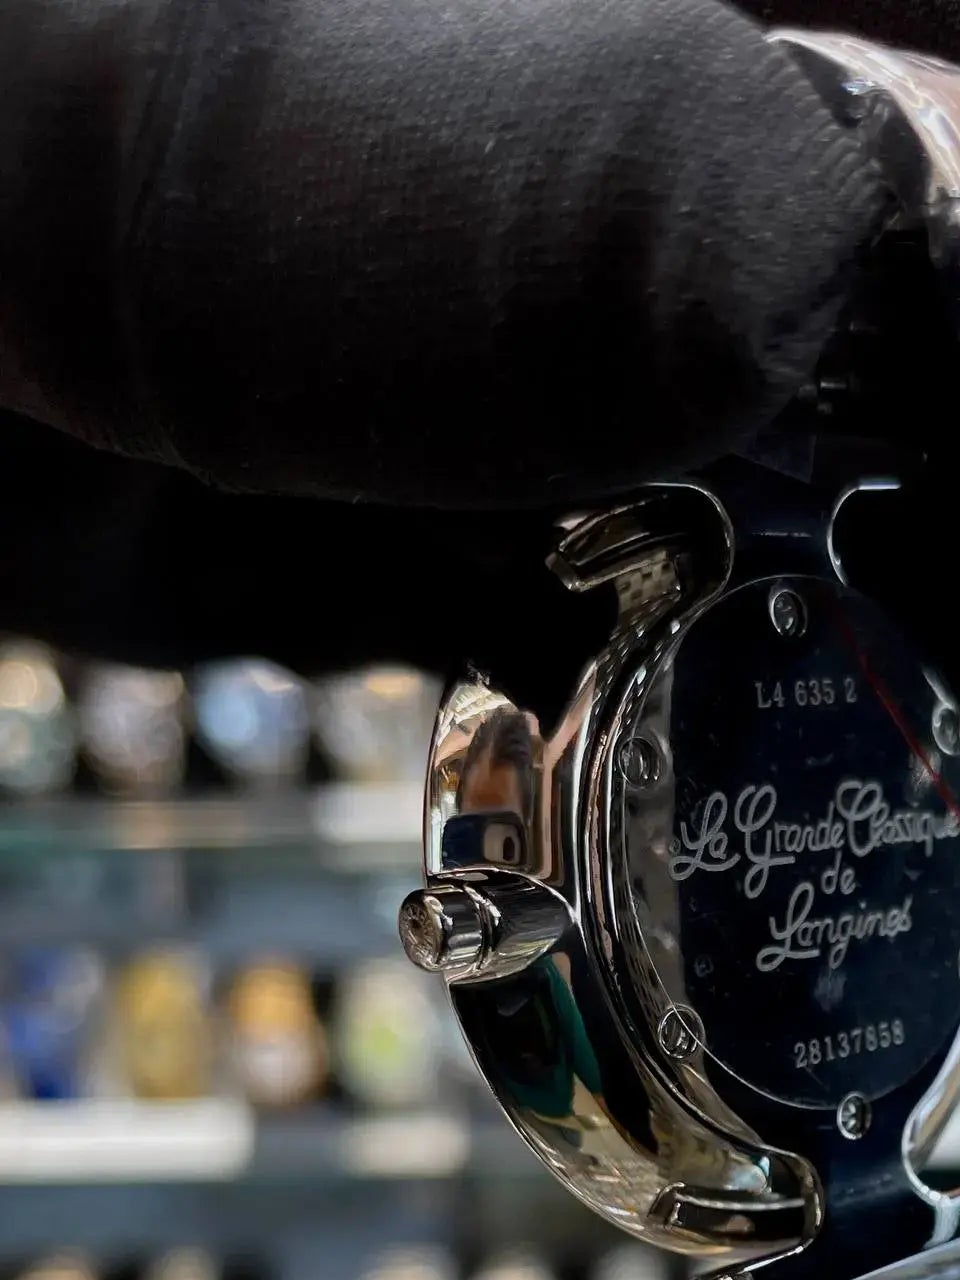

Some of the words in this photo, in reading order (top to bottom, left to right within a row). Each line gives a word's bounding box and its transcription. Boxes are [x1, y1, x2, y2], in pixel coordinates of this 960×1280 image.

[754, 680, 785, 709] L4
[795, 678, 835, 706] 635
[843, 677, 857, 703] 2
[668, 792, 741, 880] La
[734, 784, 845, 899] Grande
[821, 852, 857, 895] de
[756, 881, 912, 972] Longines
